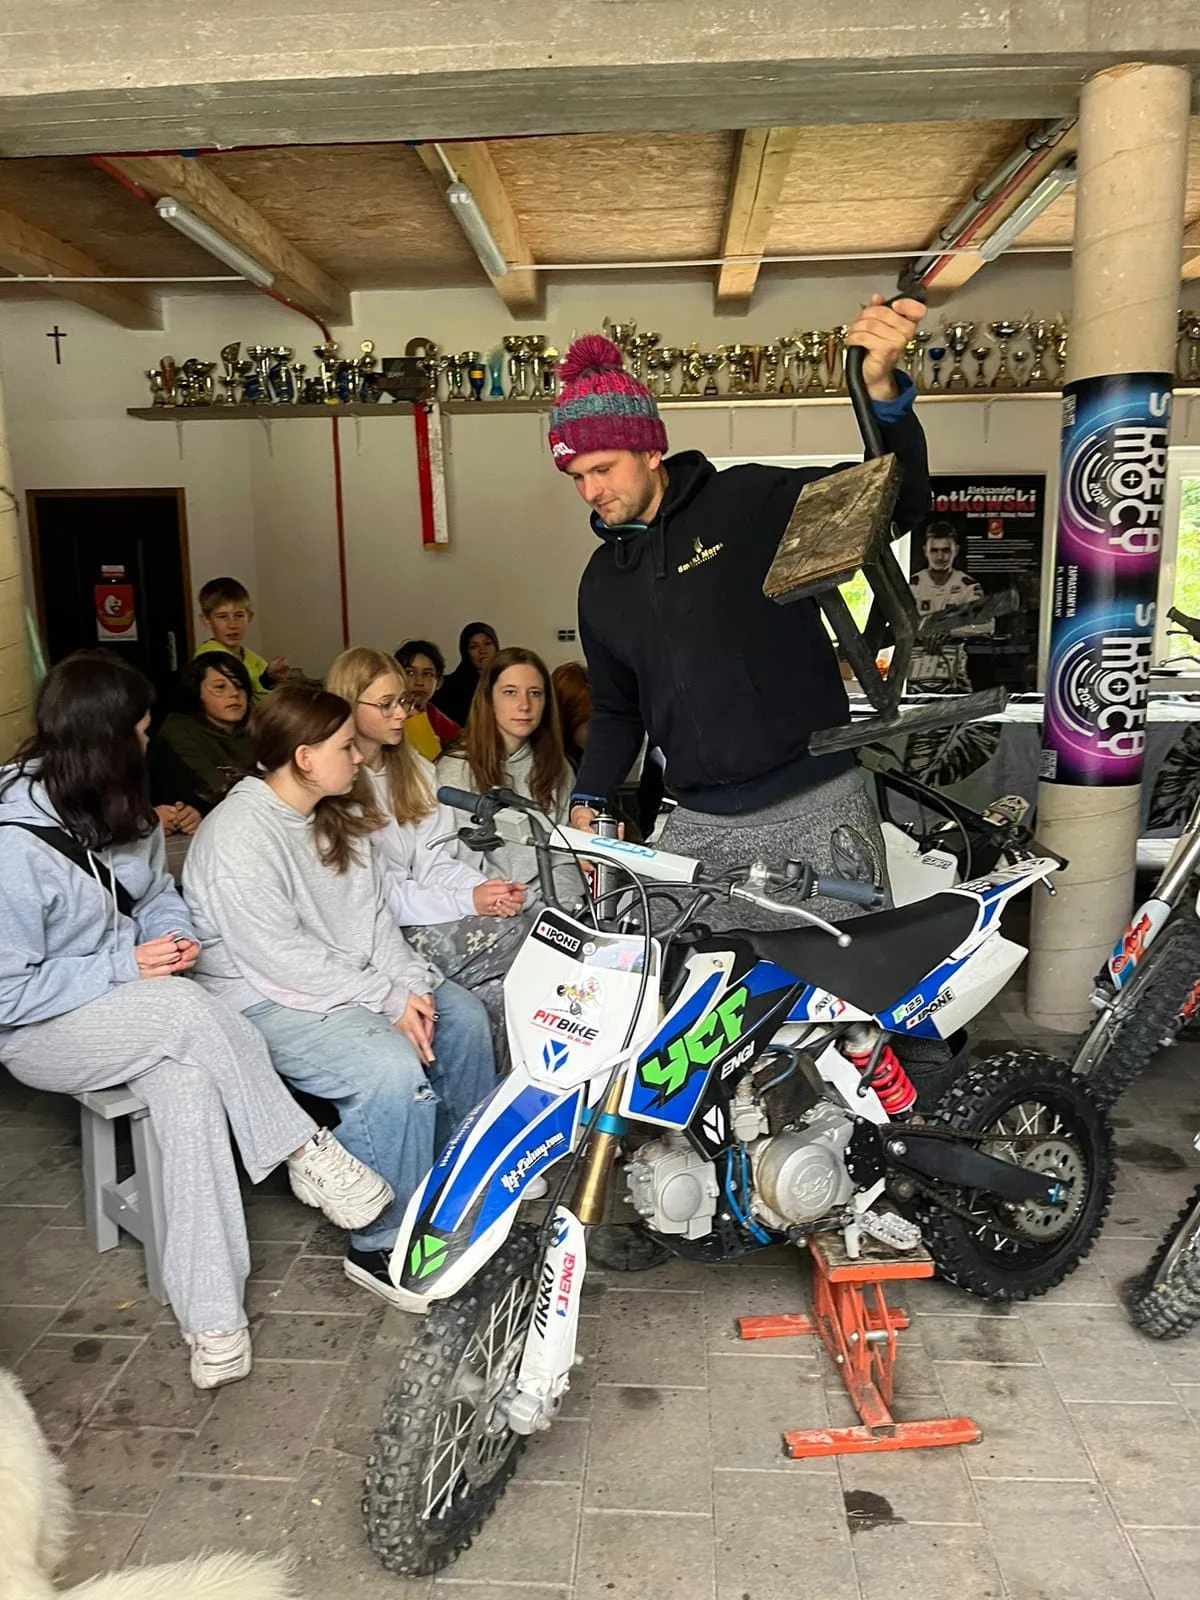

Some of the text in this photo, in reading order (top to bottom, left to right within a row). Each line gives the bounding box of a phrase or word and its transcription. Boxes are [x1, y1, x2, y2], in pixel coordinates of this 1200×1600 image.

[930, 489, 1037, 512] otkowski
[1089, 482, 1111, 508] 2024
[1109, 427, 1151, 554] MOCY
[1065, 564, 1078, 618] ZAPRASZAMY NA
[1078, 687, 1099, 713] 2024
[1097, 637, 1138, 756] MOCY
[546, 927, 579, 951] IPONE
[917, 990, 954, 1021] IPONE
[533, 1009, 599, 1041] PITBIKE
[720, 1040, 755, 1081] ENGI
[559, 1252, 576, 1294] ENGI
